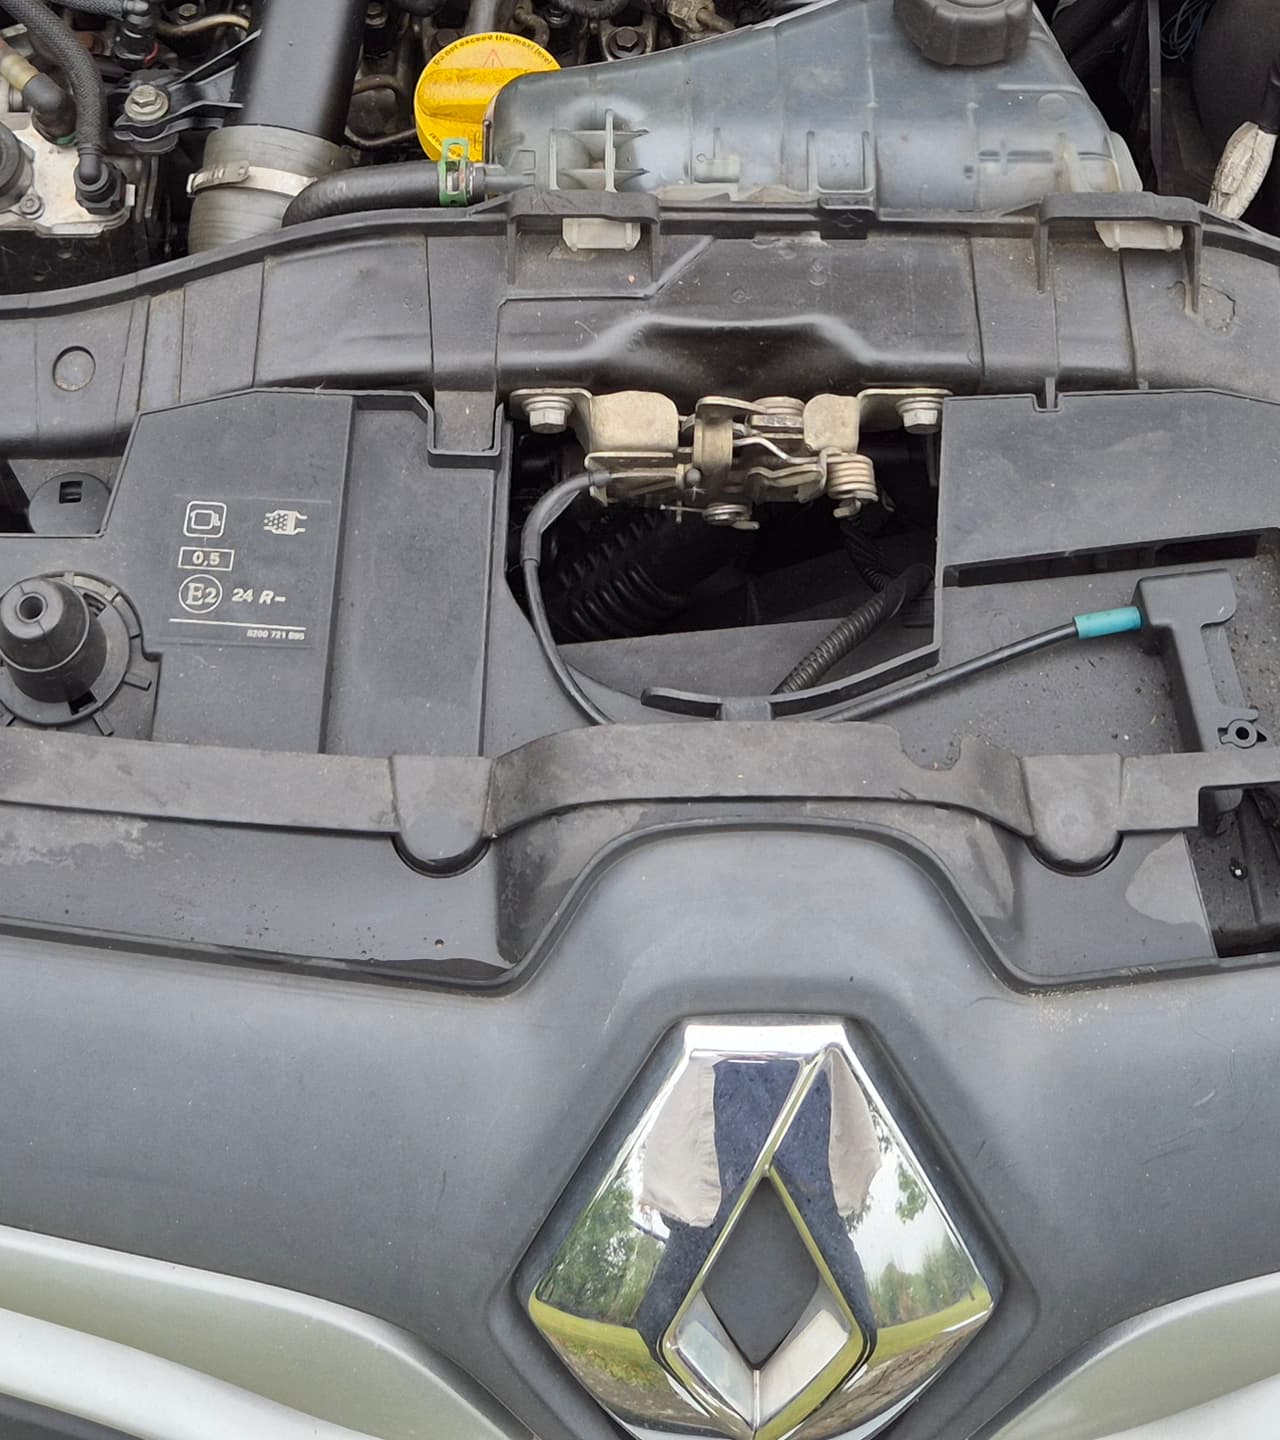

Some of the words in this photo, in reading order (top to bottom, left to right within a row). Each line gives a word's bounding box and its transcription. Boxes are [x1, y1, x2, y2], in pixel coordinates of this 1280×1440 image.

[434, 56, 445, 66] Do
[445, 44, 458, 56] not
[460, 34, 493, 47] exceed
[513, 38, 536, 50] maxi
[534, 48, 553, 65] level
[192, 551, 220, 566] 0,5
[232, 588, 254, 603] 24
